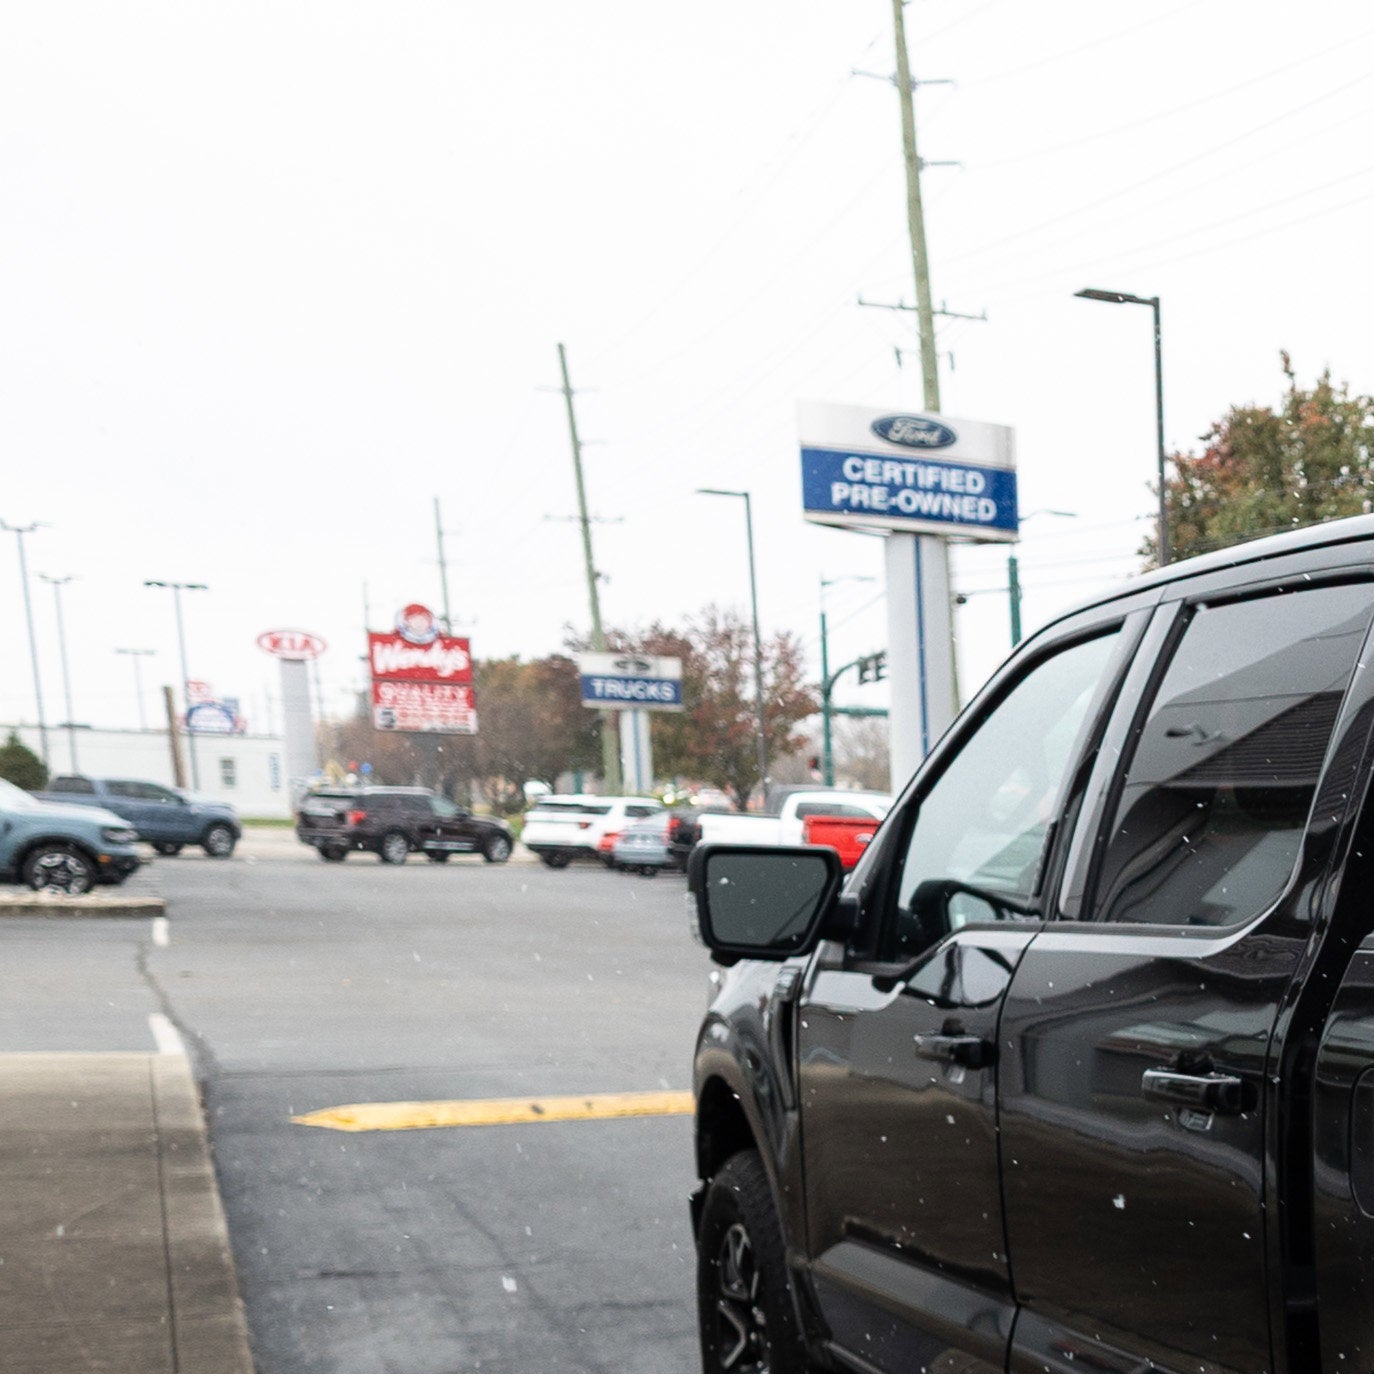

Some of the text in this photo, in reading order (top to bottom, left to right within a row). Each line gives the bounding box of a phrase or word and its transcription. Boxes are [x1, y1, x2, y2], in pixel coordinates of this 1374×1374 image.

[887, 417, 943, 446] Ford
[842, 456, 986, 495] CERTIFIED
[831, 482, 997, 522] PRE-OWNED
[590, 679, 676, 701] TRUCKS
